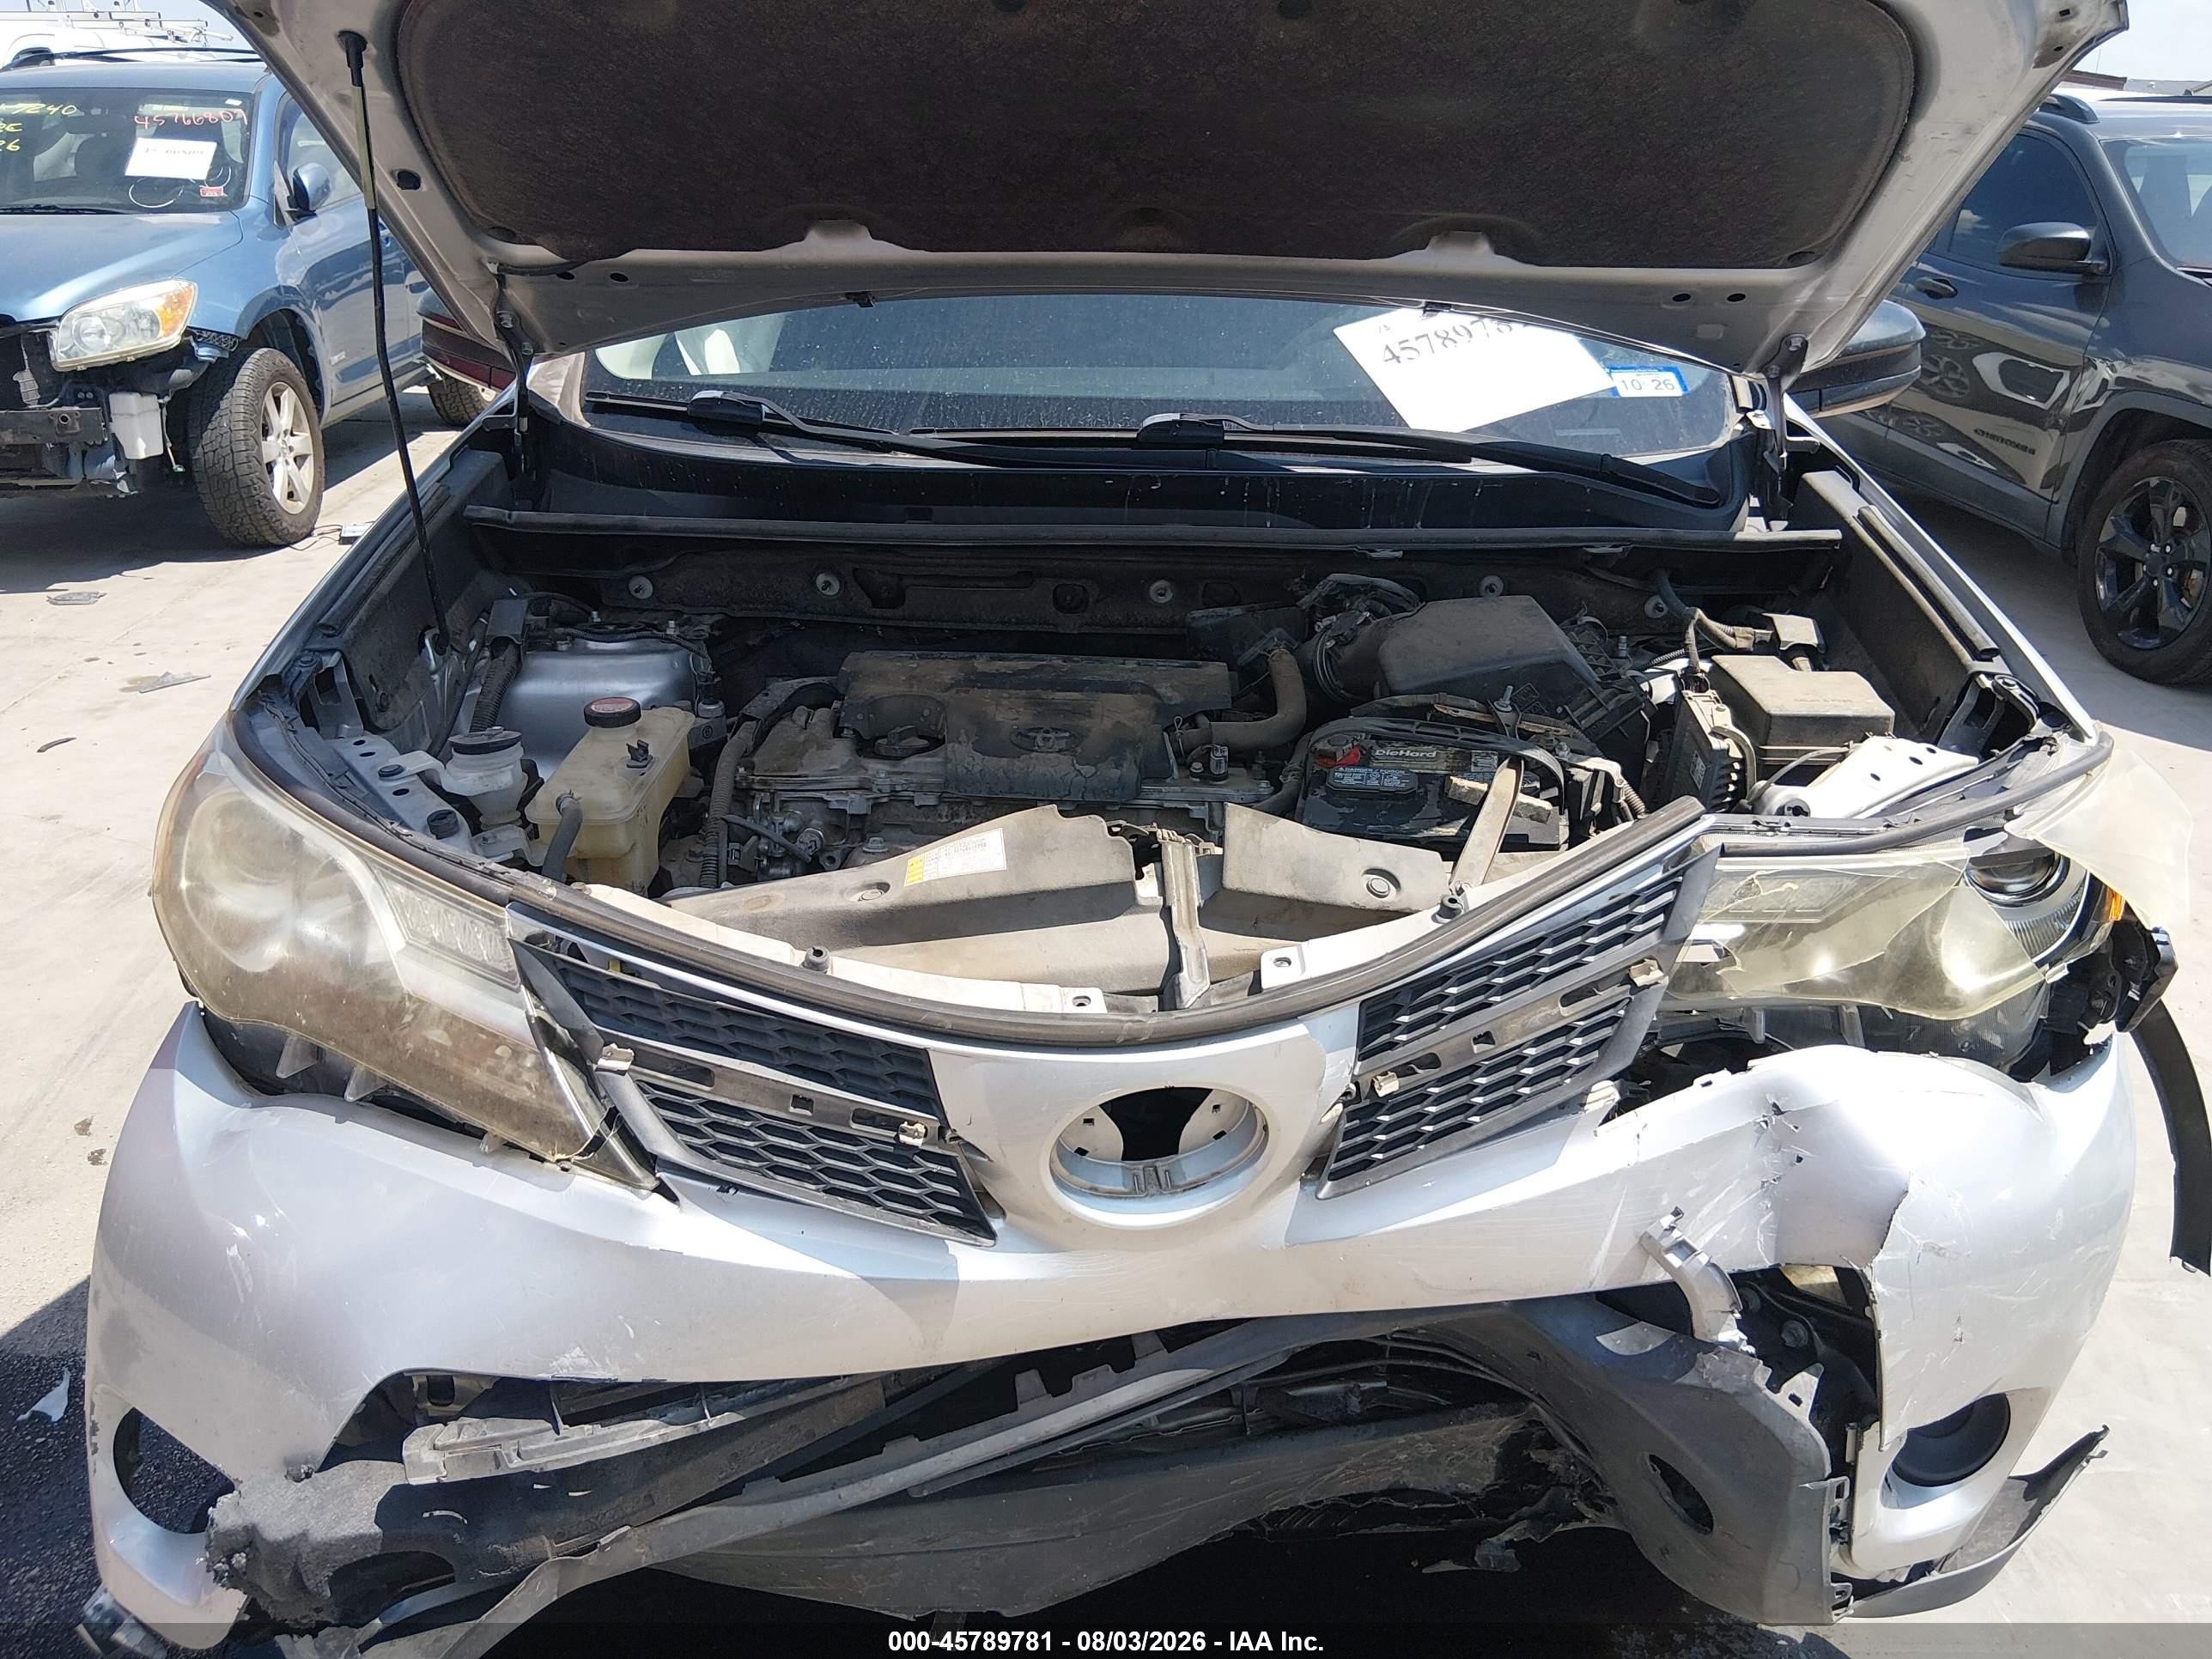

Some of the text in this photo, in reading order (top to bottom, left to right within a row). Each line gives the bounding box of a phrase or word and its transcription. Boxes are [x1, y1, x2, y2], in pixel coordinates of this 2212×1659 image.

[1621, 379, 1675, 391] 10 26
[1375, 748, 1437, 758] DieHard
